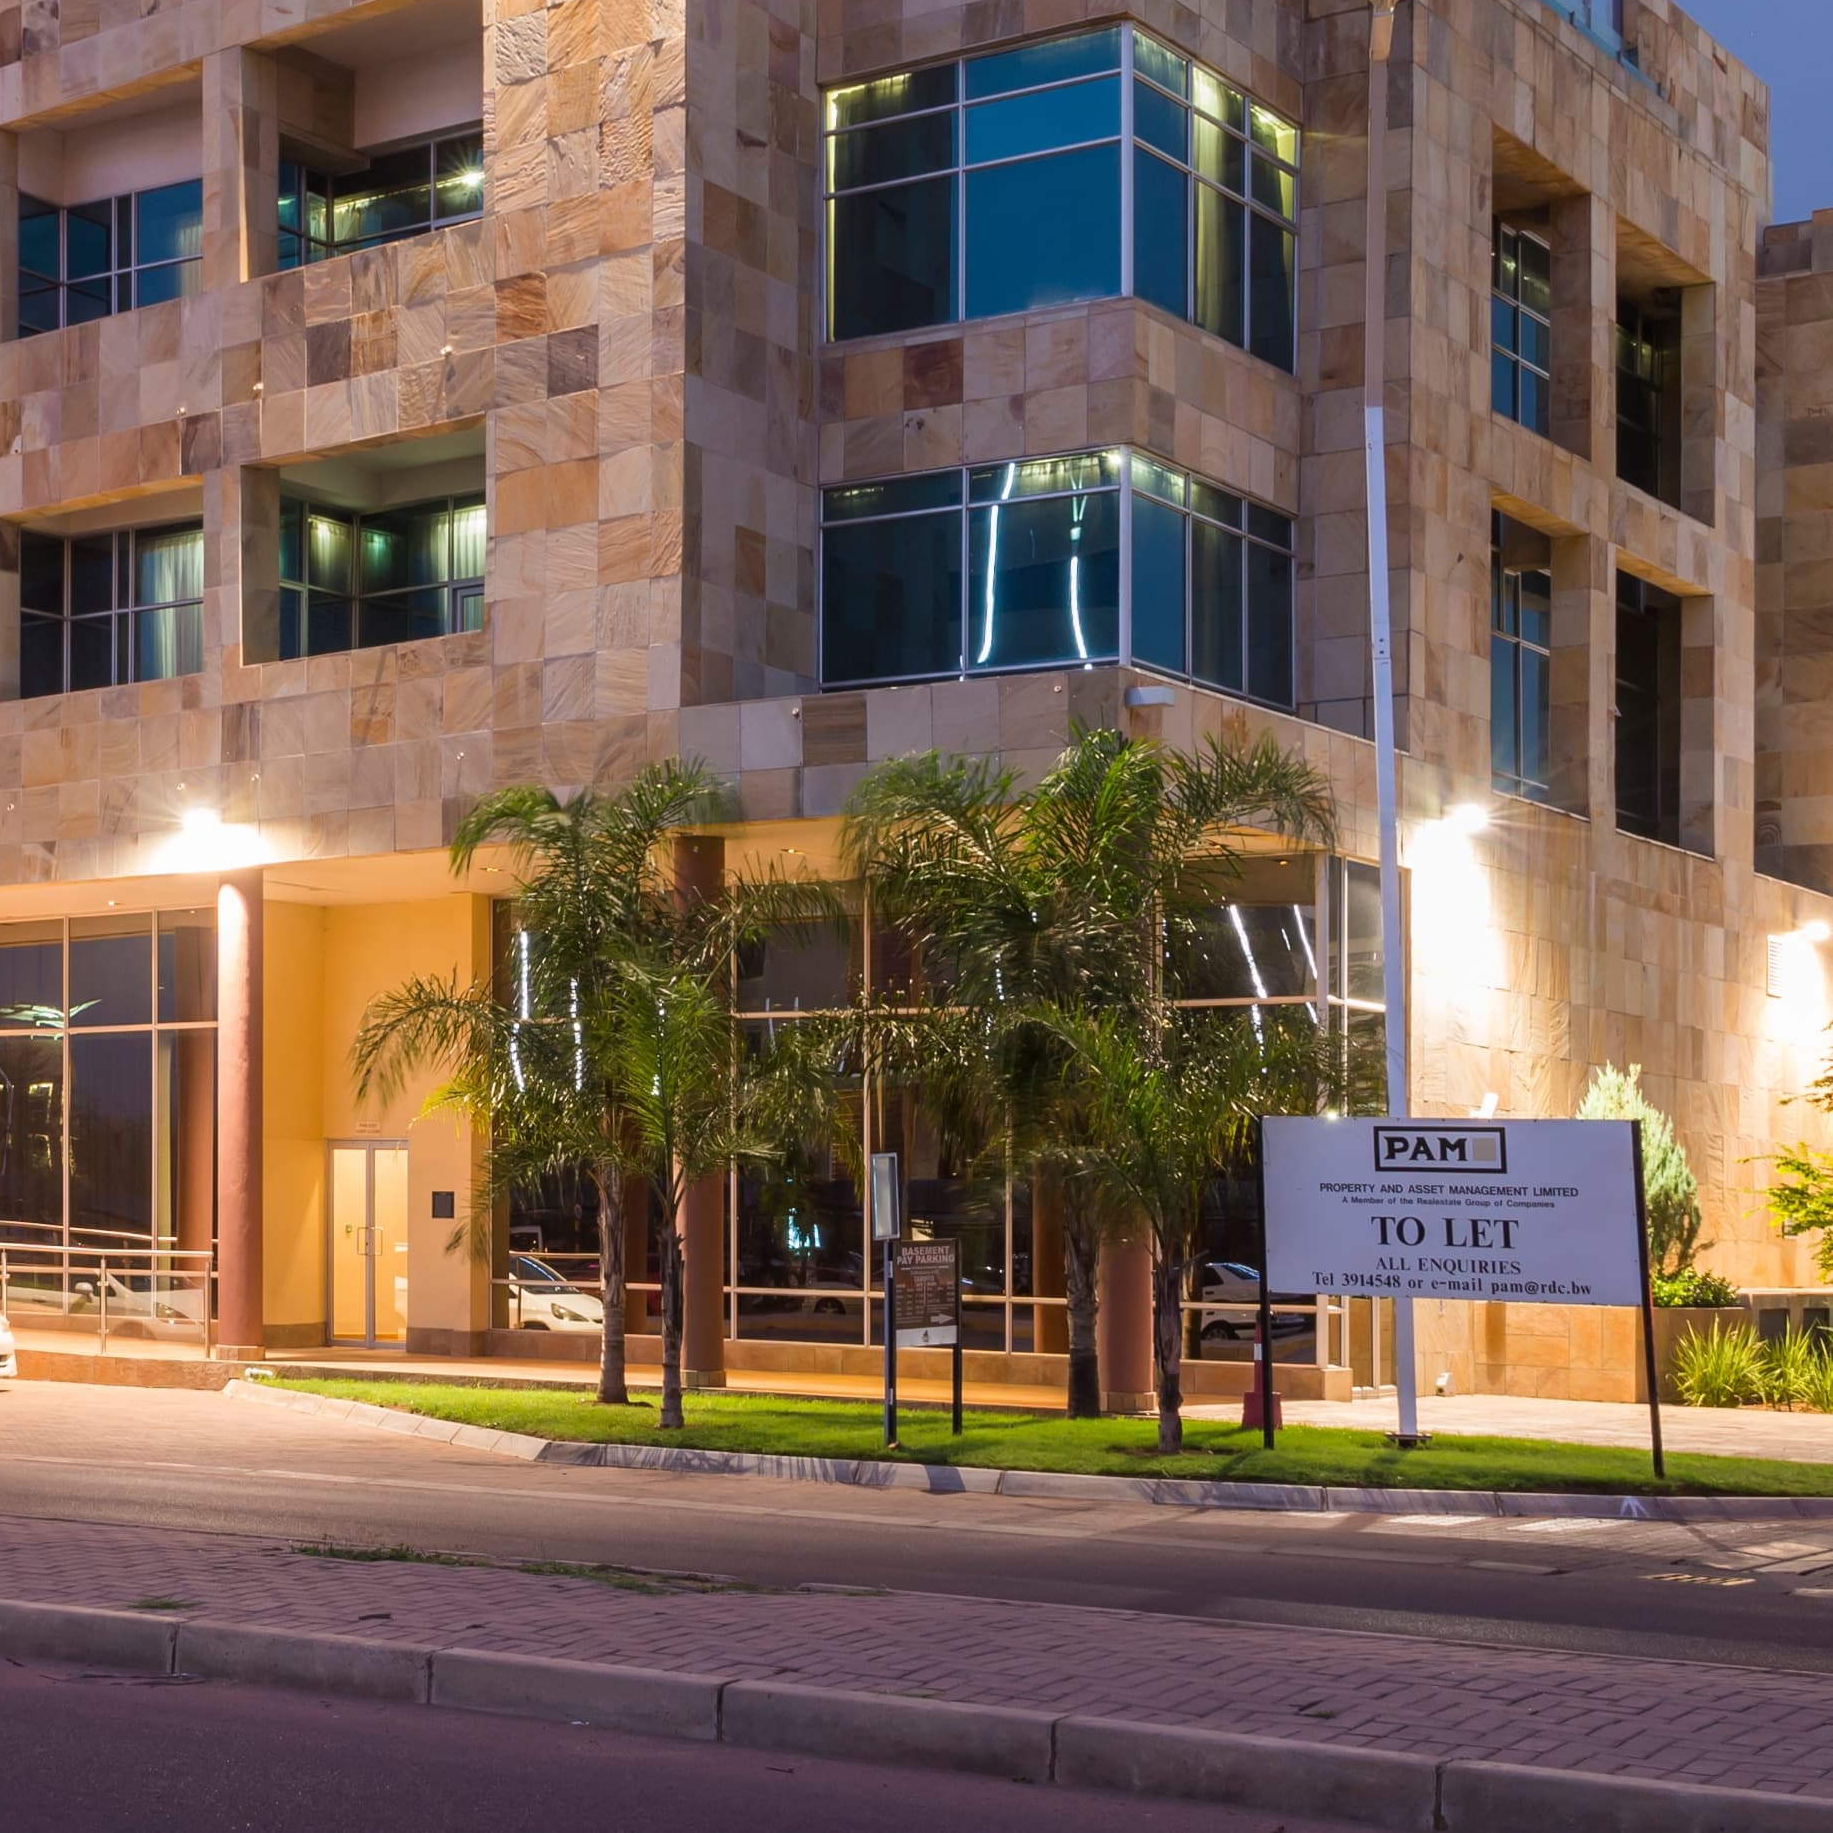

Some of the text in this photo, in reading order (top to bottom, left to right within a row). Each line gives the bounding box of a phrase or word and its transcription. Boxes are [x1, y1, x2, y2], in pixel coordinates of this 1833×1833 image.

[1383, 1136, 1468, 1162] PAM
[1319, 1182, 1579, 1198] PROPERTY AND ASSET MANAGEMENT LIMITED
[1342, 1196, 1349, 1204] A
[1351, 1196, 1385, 1205] Member
[1388, 1197, 1397, 1206] of
[1400, 1197, 1414, 1205] the
[1465, 1198, 1491, 1208] Group
[1494, 1199, 1503, 1207] of
[1506, 1199, 1556, 1209] Companies
[1371, 1216, 1520, 1249] TO LET
[896, 1253, 955, 1265] PAY PARKING
[901, 1246, 950, 1256] BASEMENT
[1376, 1257, 1522, 1275] ALL ENQUIRIES
[1312, 1271, 1592, 1296] Tel 3914548 or e-mail pam@rdc.bw
